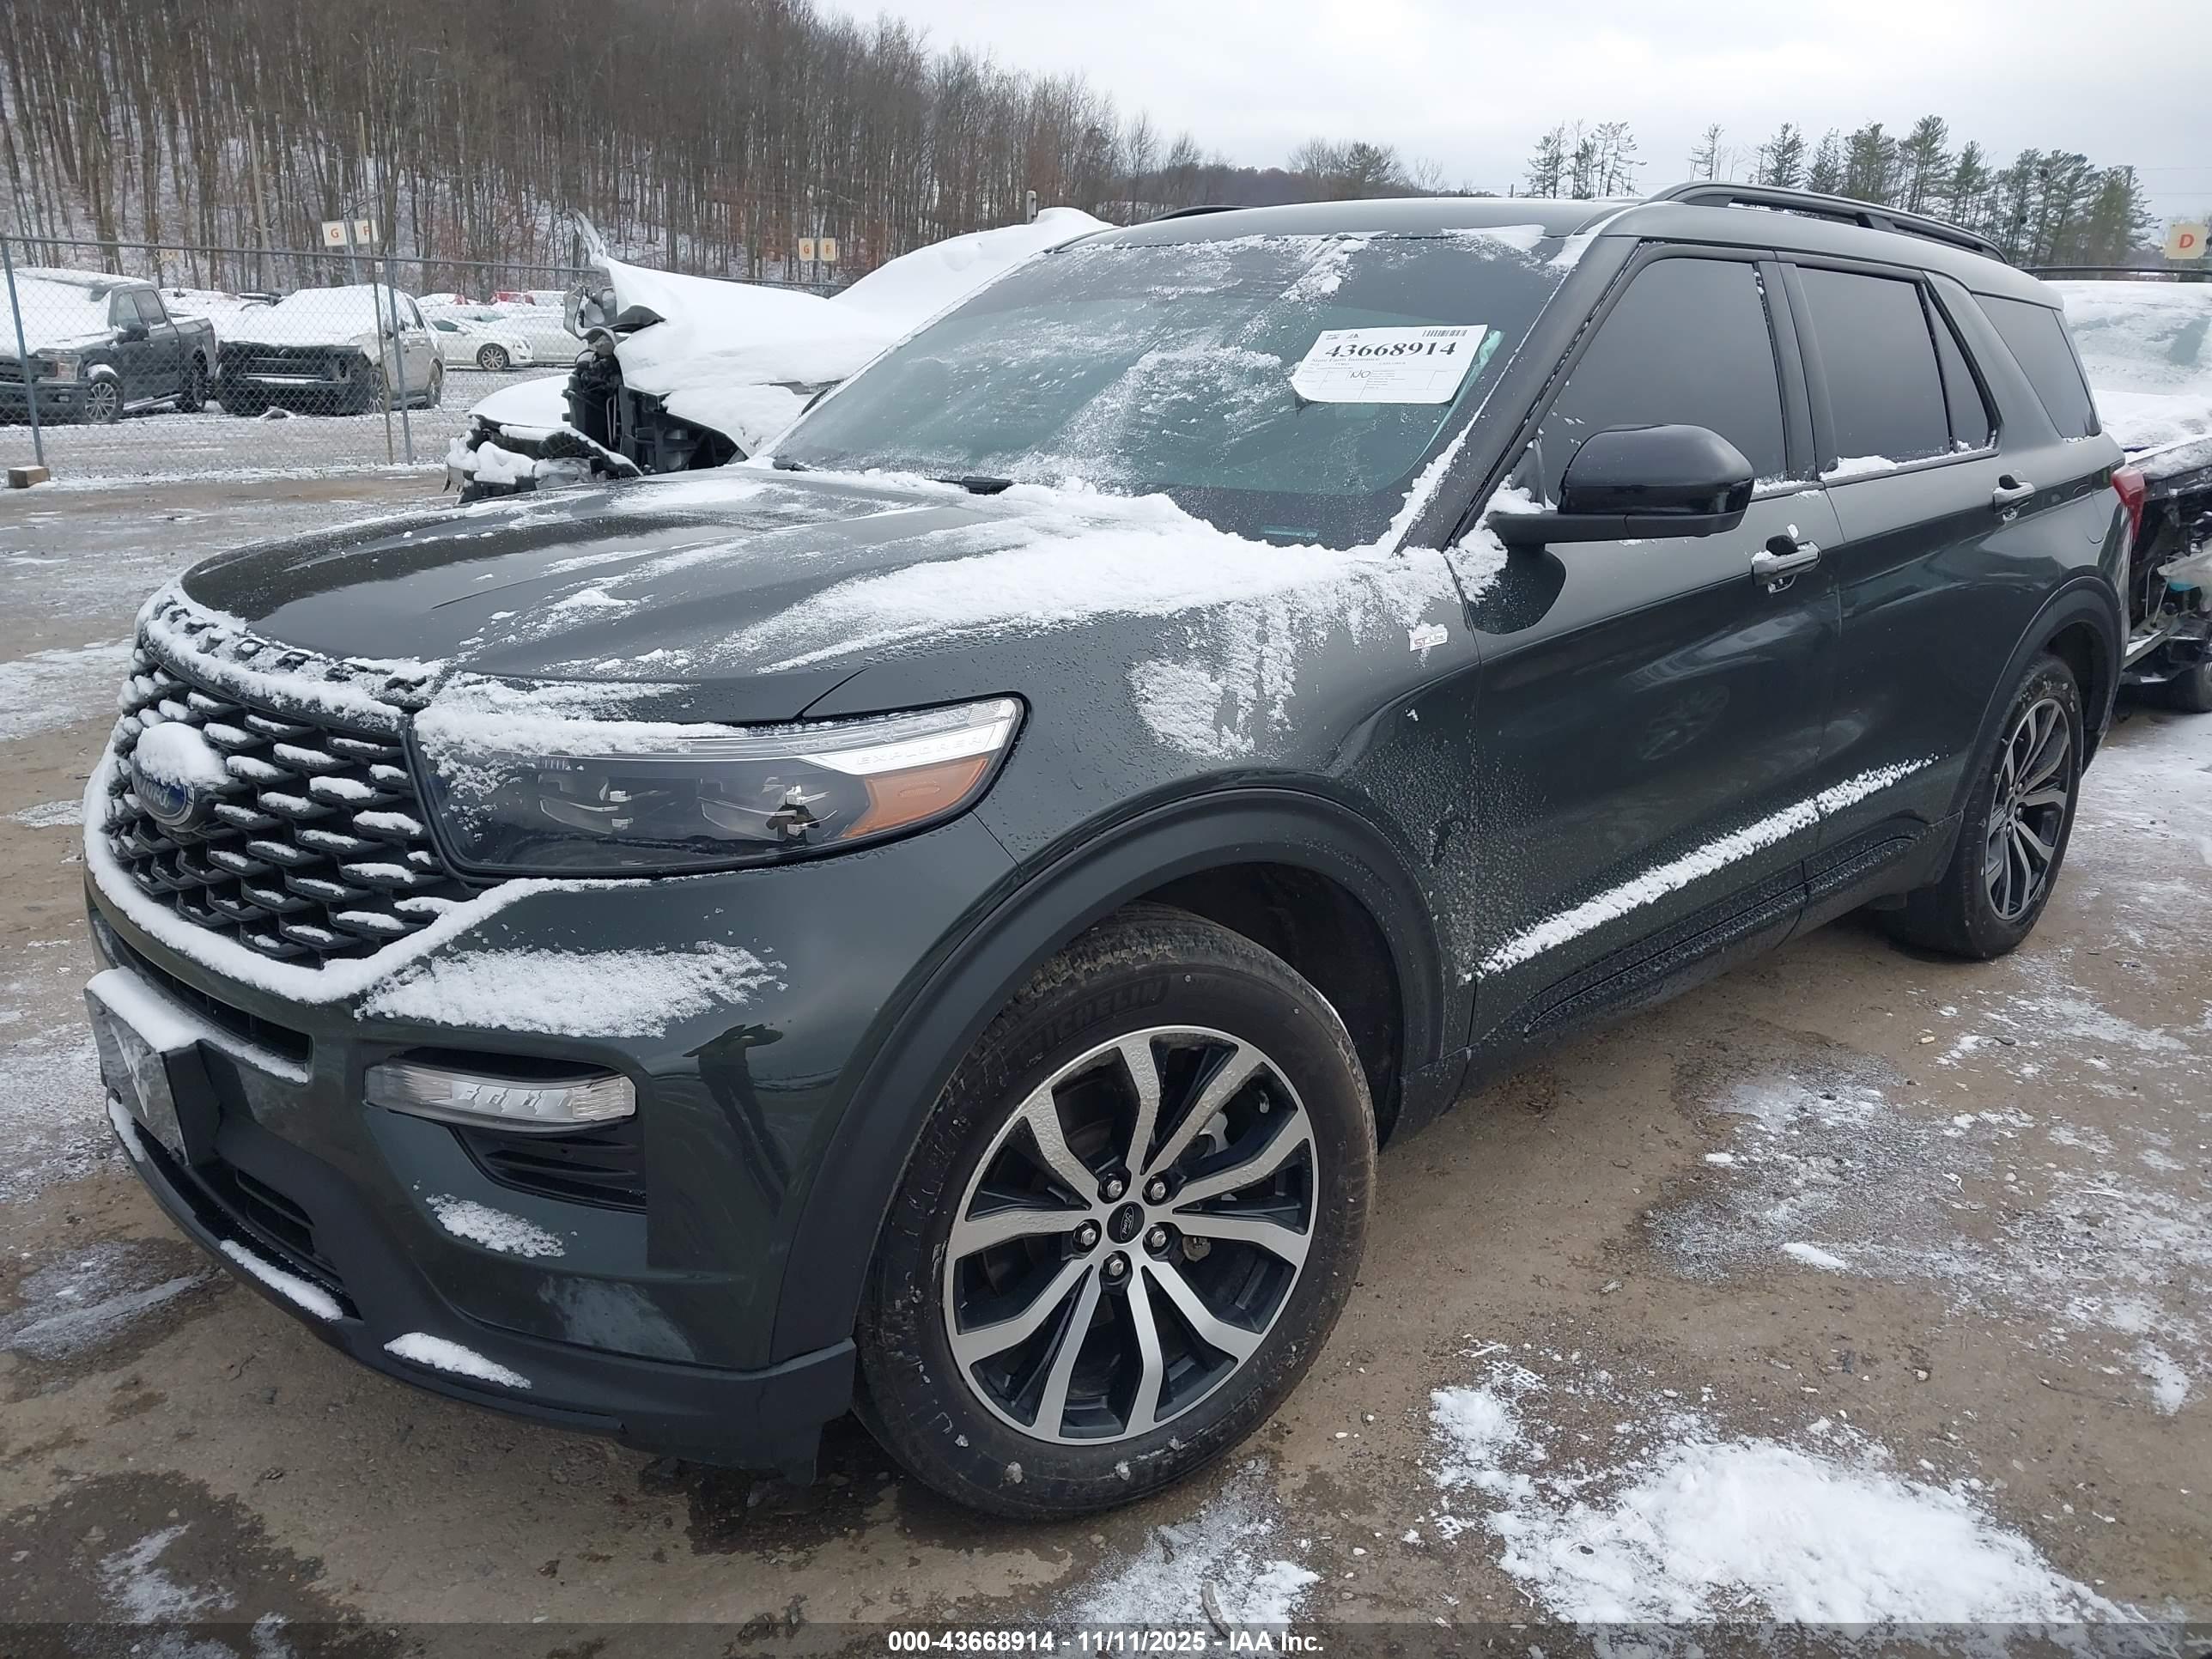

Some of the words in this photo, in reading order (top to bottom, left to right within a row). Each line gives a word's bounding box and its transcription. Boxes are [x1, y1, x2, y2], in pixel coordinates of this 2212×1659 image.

[330, 228, 339, 238] G
[2179, 234, 2195, 248] D
[803, 244, 810, 254] G
[825, 244, 830, 254] F
[1325, 342, 1456, 357] 43668914
[858, 735, 986, 765] EXPLORER
